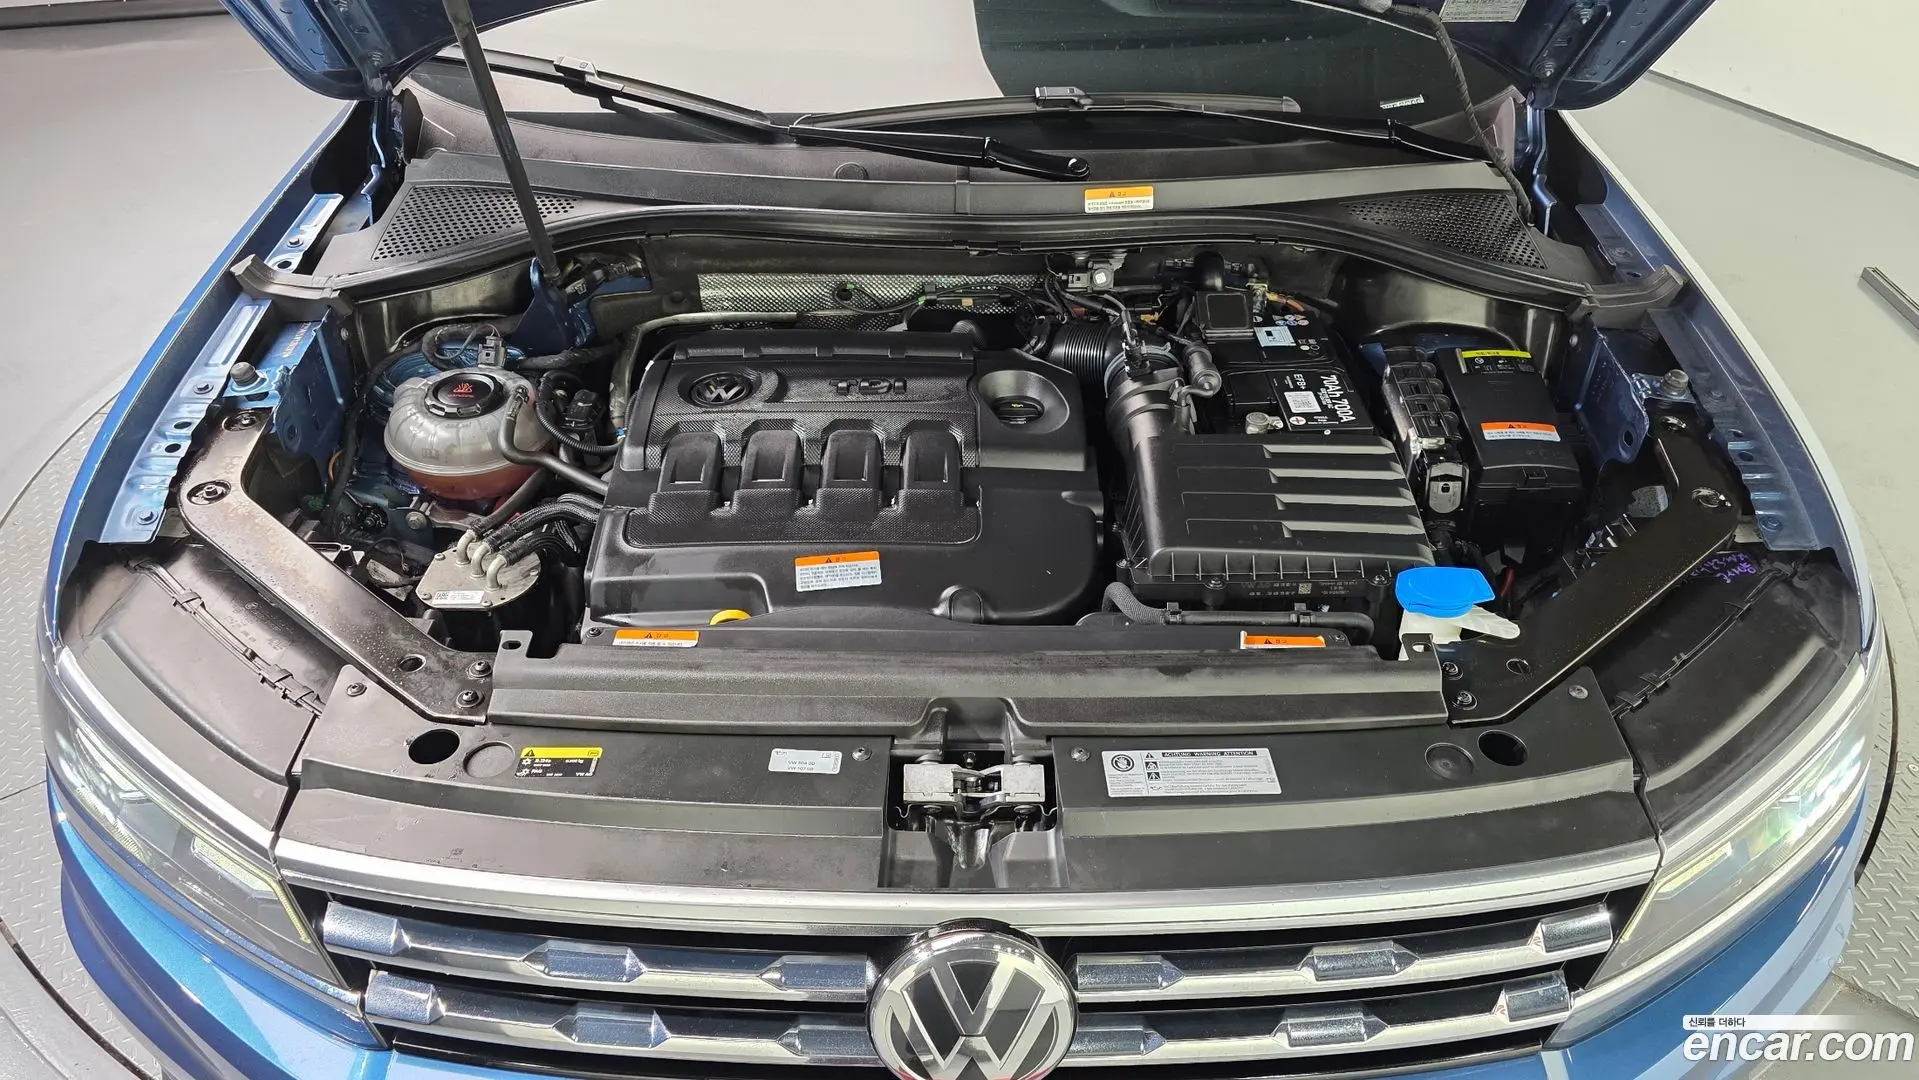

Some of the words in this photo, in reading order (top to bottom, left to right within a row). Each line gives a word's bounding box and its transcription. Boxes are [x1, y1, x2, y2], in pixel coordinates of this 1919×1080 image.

[829, 377, 907, 396] TDI
[1320, 374, 1344, 398] 70Ah
[1331, 398, 1357, 423] 700A
